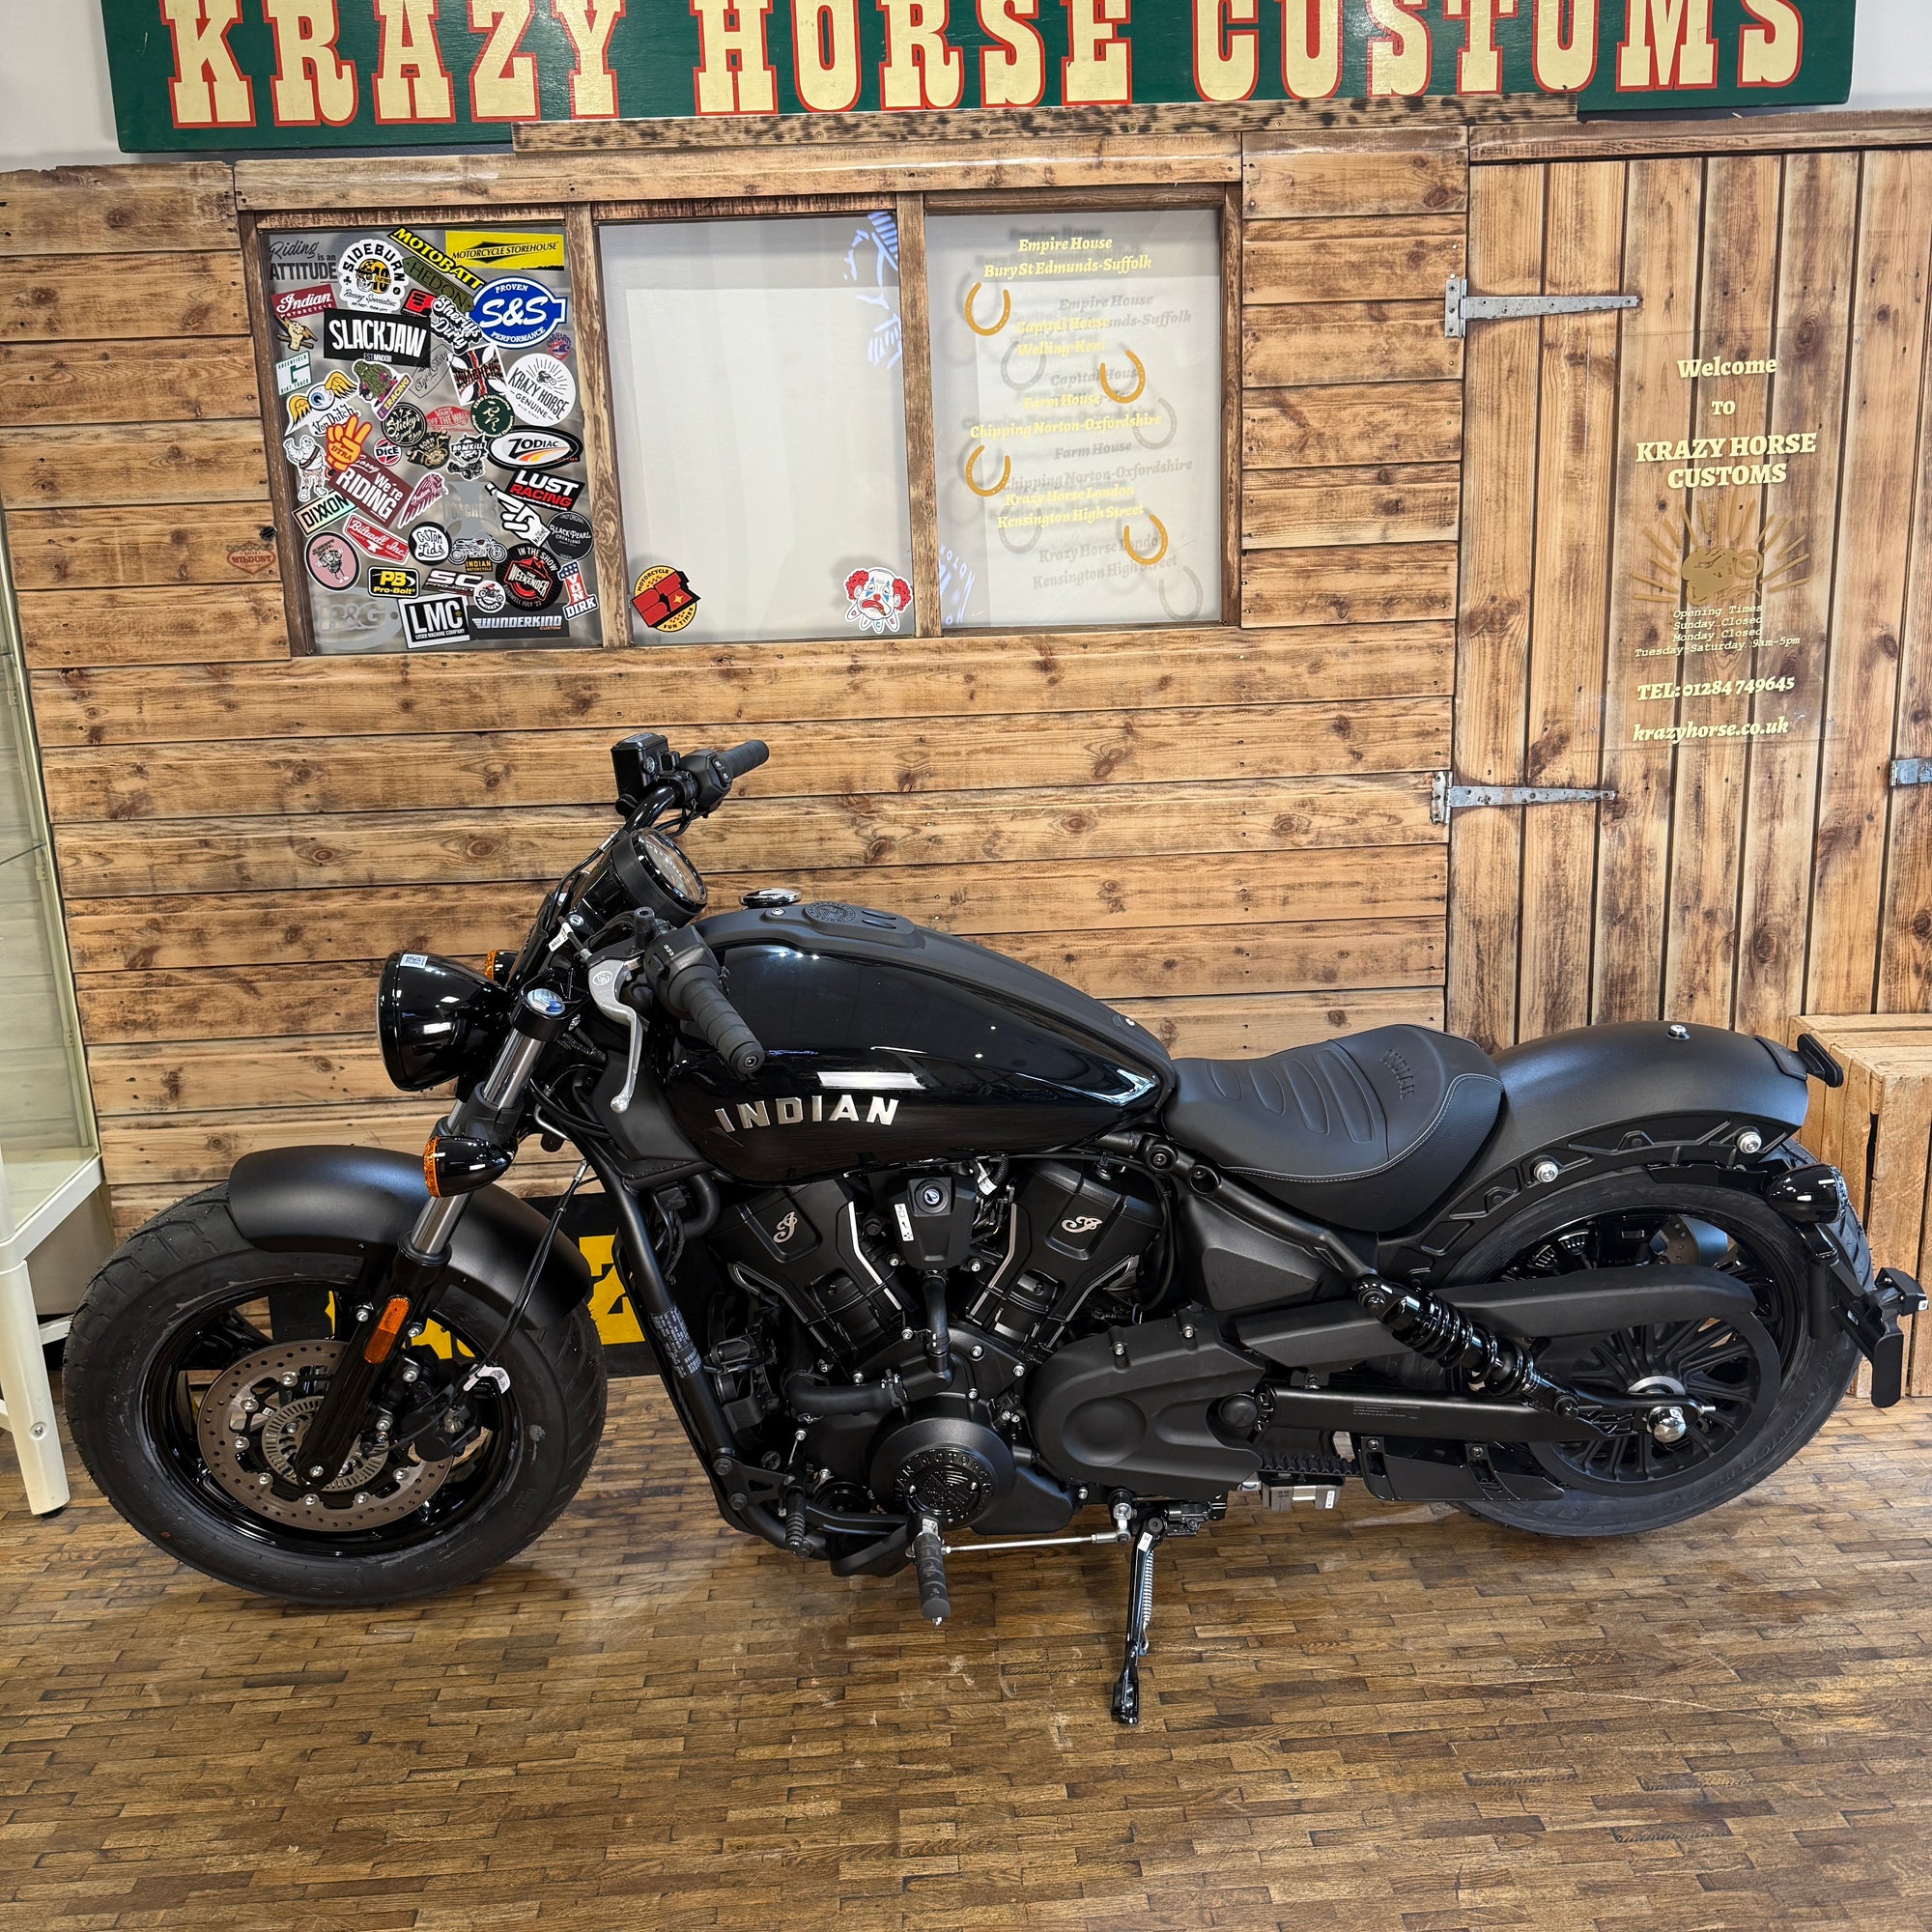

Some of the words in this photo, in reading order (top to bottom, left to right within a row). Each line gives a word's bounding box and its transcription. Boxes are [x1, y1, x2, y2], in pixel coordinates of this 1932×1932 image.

[166, 0, 626, 128] KRAZY
[691, 0, 1132, 116] HORSE
[1193, 0, 1804, 101] CUSTOMS
[270, 241, 320, 260] Riding
[452, 245, 504, 260] MOTORCYCLE
[506, 242, 557, 254] STOREHOUSE
[1018, 237, 1069, 255] Empire
[1069, 237, 1113, 250] House
[343, 243, 406, 282] SIDEBURN
[393, 228, 485, 290] MOTOBATT
[983, 264, 1017, 280] Bury
[1019, 263, 1036, 276] St
[1036, 255, 1151, 275] Edmunds-Suffolk
[270, 263, 338, 280] ATTITUDE
[410, 262, 469, 308] HEDON
[496, 283, 528, 294] PROVEN
[276, 293, 332, 313] Indian
[280, 303, 332, 318] MOTORCYCLE
[480, 296, 549, 327] S&S
[329, 319, 427, 358] SLACKJAW
[431, 317, 469, 351] Dirty
[491, 326, 546, 343] PERFORMANCE
[1016, 318, 1066, 335] Capital
[1068, 318, 1109, 331] House
[1677, 355, 1777, 379] Welcome
[386, 378, 410, 406] RACING
[508, 367, 541, 397] KRAZY
[537, 389, 570, 420] HORSE
[1022, 395, 1059, 410] Farm
[1060, 393, 1101, 407] House
[515, 393, 548, 418] GENUINE
[1711, 400, 1736, 415] TO
[312, 418, 328, 436] Von
[970, 424, 1031, 440] Chipping
[1034, 413, 1163, 435] Norton-Oxfordshire
[331, 446, 353, 462] DTRA
[508, 438, 559, 459] ZODIAC
[1635, 438, 1726, 463] KRAZY
[1729, 433, 1817, 457] HORSE
[515, 469, 580, 497] LUST
[1667, 463, 1787, 489] CUSTOMS
[336, 468, 397, 520] RIDING
[509, 483, 573, 507] RACING
[1005, 492, 1043, 507] Krazy
[1047, 490, 1084, 502] Horse
[1086, 484, 1134, 498] London
[300, 495, 350, 528] DIXXON
[997, 511, 1070, 528] Kensington
[1073, 507, 1103, 523] High
[1105, 503, 1144, 519] Street
[348, 520, 388, 546] Biltwell
[416, 529, 442, 545] CUSTOM
[417, 542, 445, 557] Lids
[518, 547, 526, 556] IN
[526, 547, 541, 557] THE
[540, 553, 558, 571] SHOW
[373, 586, 412, 595] Pro-Bolt
[380, 571, 407, 587] PB
[427, 570, 482, 588] SC
[508, 564, 550, 597] WEEKENDER
[568, 574, 585, 602] VON
[638, 568, 669, 591] MOTORCYCLE
[320, 601, 385, 633] R&G
[409, 600, 464, 634] LMC
[565, 596, 598, 619] DIRK
[679, 608, 694, 625] TIMES
[1673, 607, 1722, 619] Opening
[1729, 604, 1763, 614] Times
[472, 615, 562, 628] WUNDERKIND
[1735, 676, 1795, 695] 749645
[1633, 717, 1788, 745] krazyhorse.co.uk
[714, 1094, 899, 1133] INDIAN
